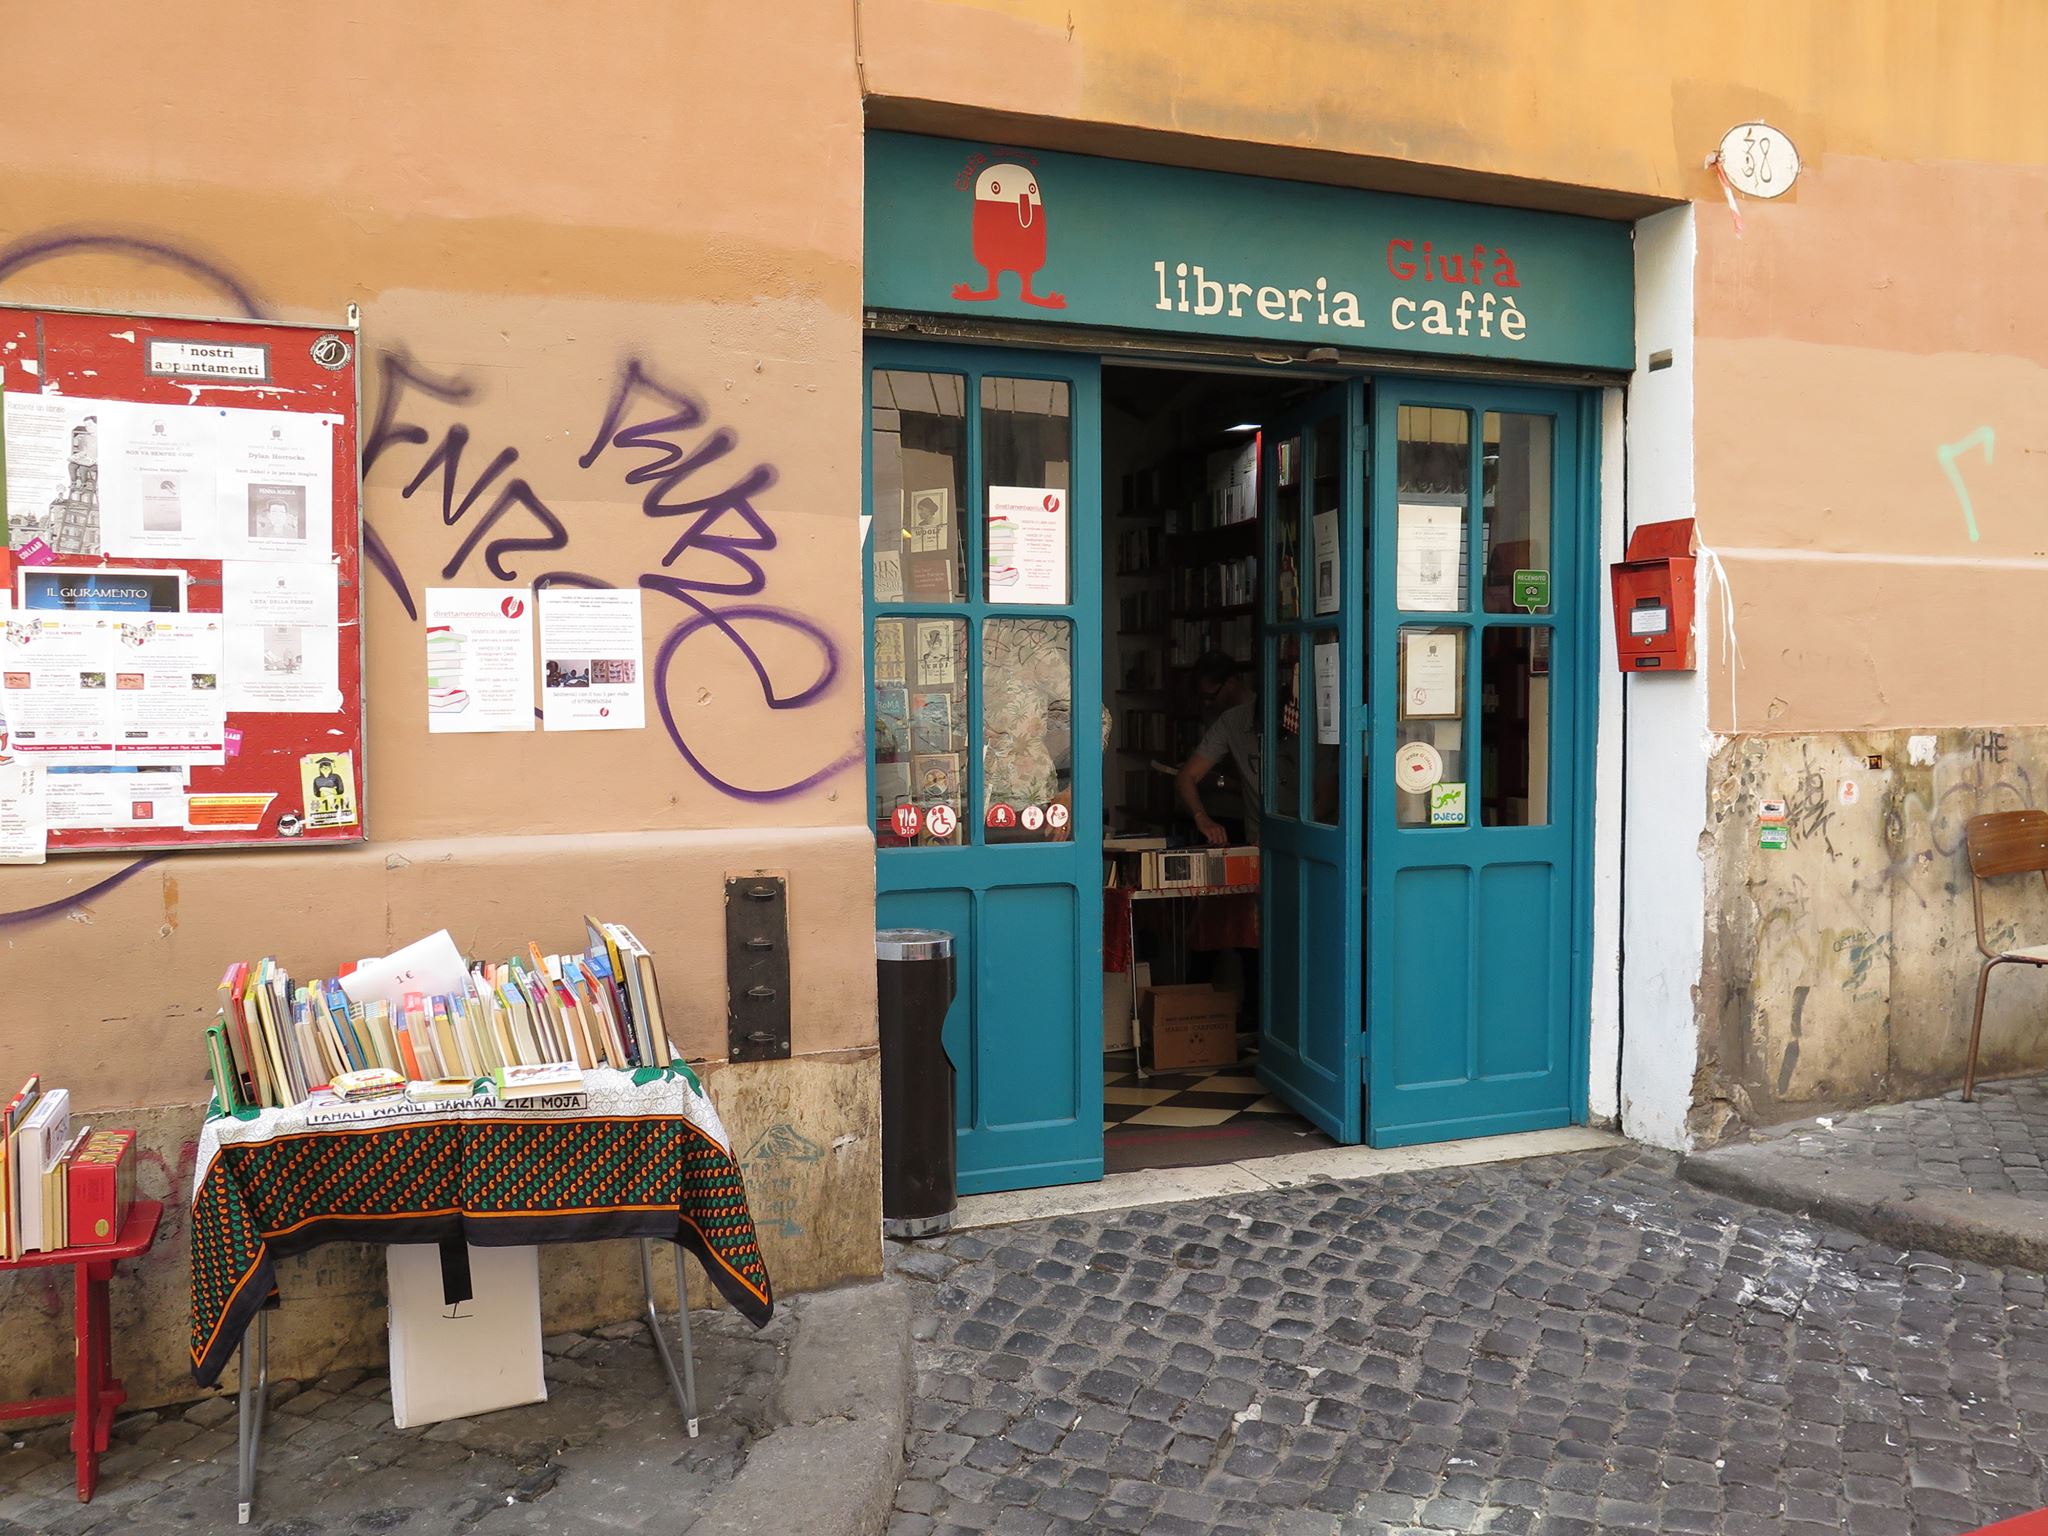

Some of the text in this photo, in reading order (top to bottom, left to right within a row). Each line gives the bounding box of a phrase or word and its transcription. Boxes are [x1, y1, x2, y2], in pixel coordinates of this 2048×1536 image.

[1387, 239, 1522, 288] Giufà
[1154, 261, 1527, 341] libreria caffè
[190, 348, 235, 358] nostri
[47, 587, 148, 599] IL GIURAMENTO
[1433, 813, 1459, 821] DJECO
[901, 826, 915, 835] bio
[505, 1097, 534, 1109] ZIZI
[541, 1096, 581, 1108] MOJA
